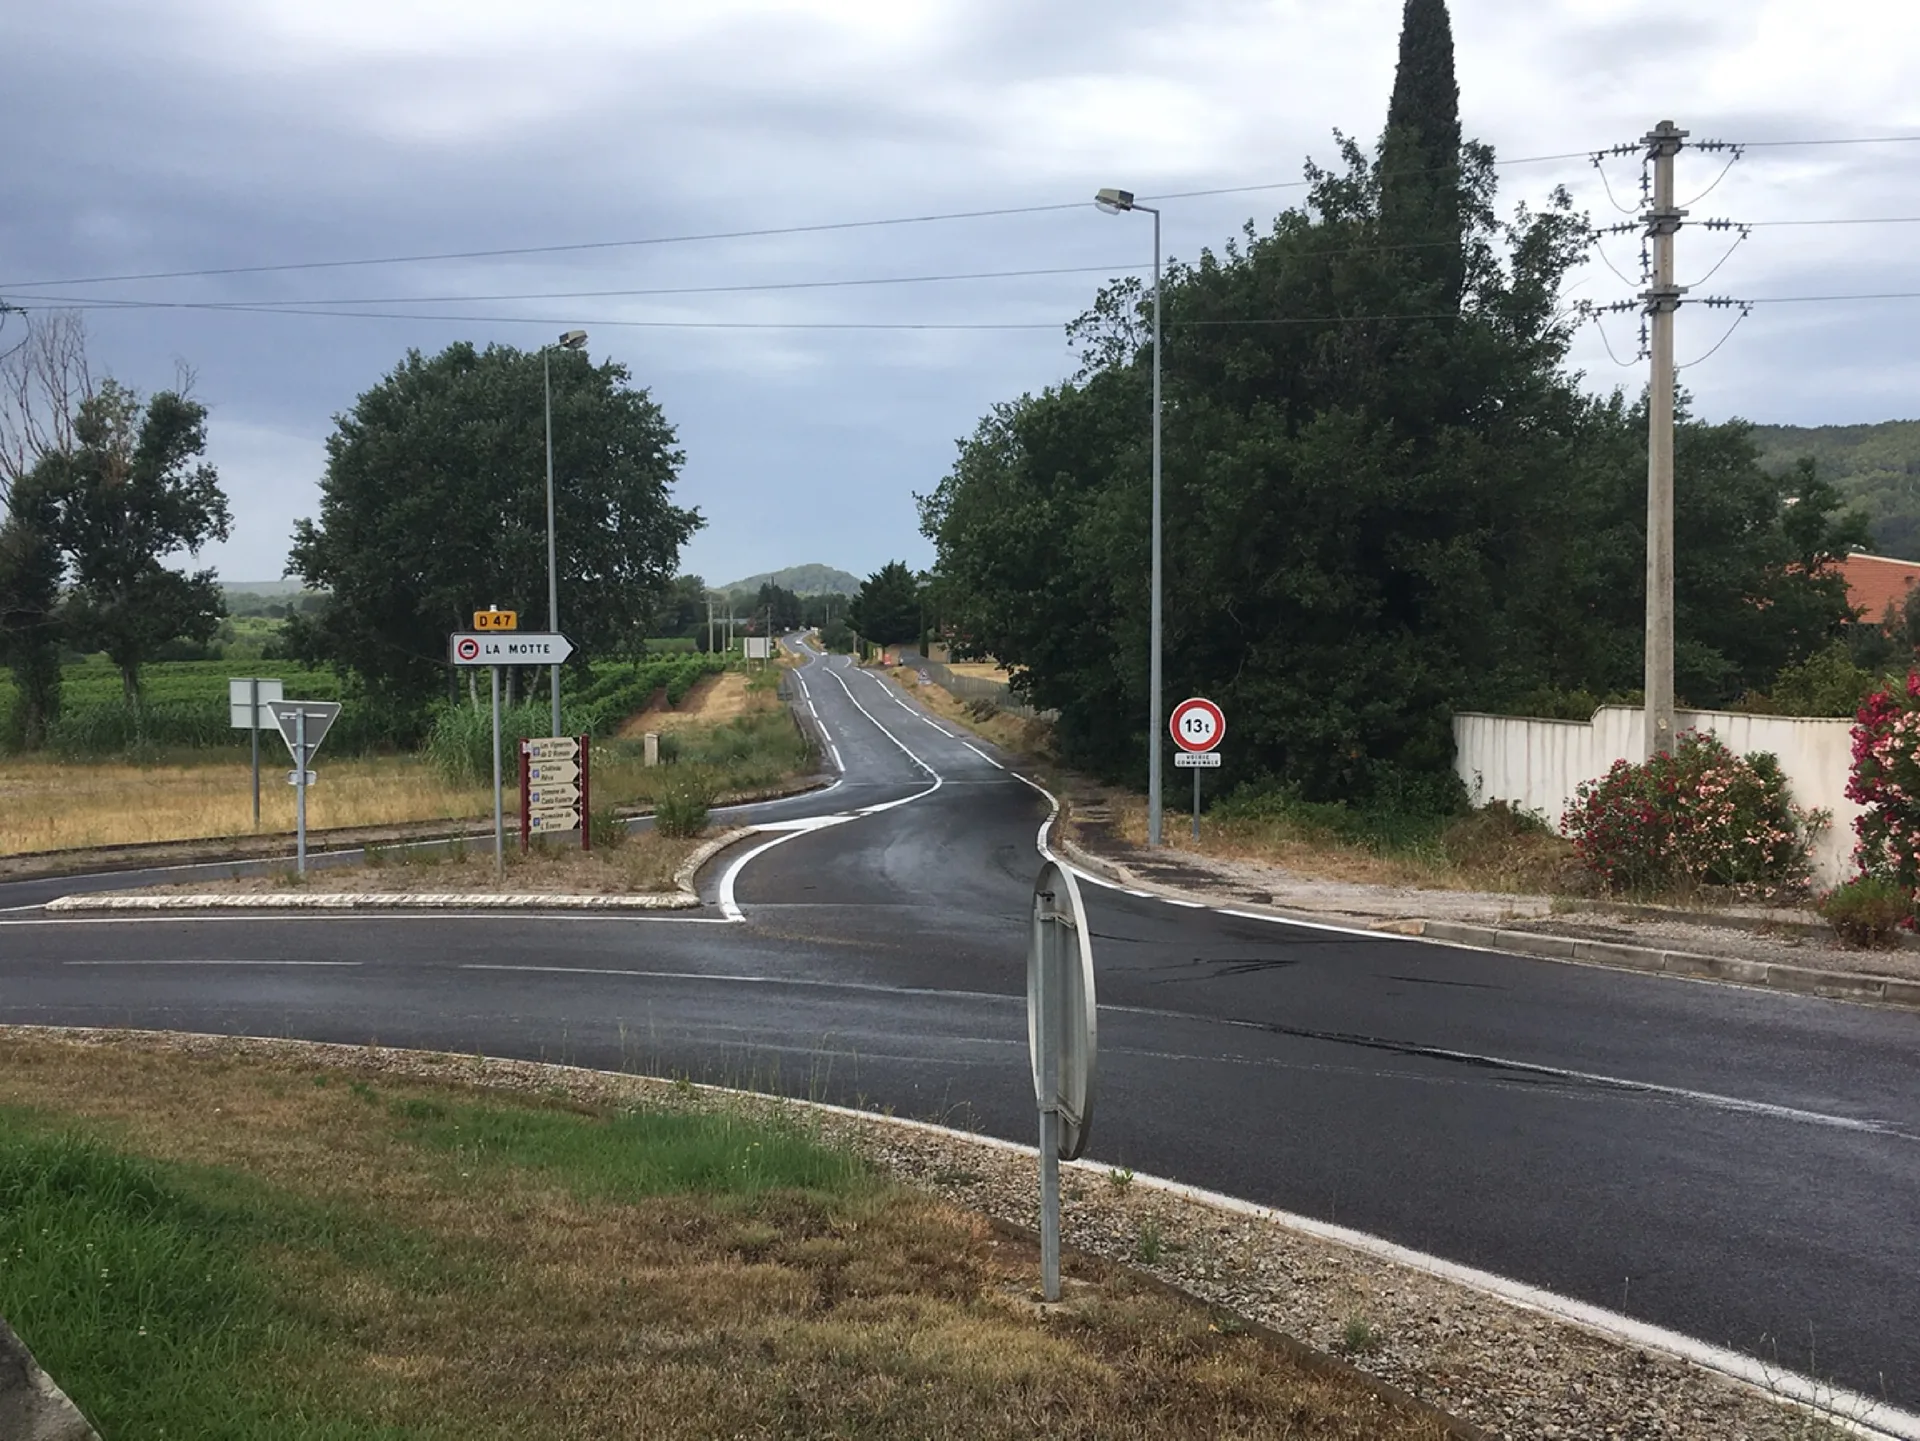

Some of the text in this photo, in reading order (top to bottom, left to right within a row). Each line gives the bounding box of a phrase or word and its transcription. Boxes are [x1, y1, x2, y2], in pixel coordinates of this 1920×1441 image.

[480, 615, 511, 626] D 47
[486, 644, 551, 655] LA MOTTE
